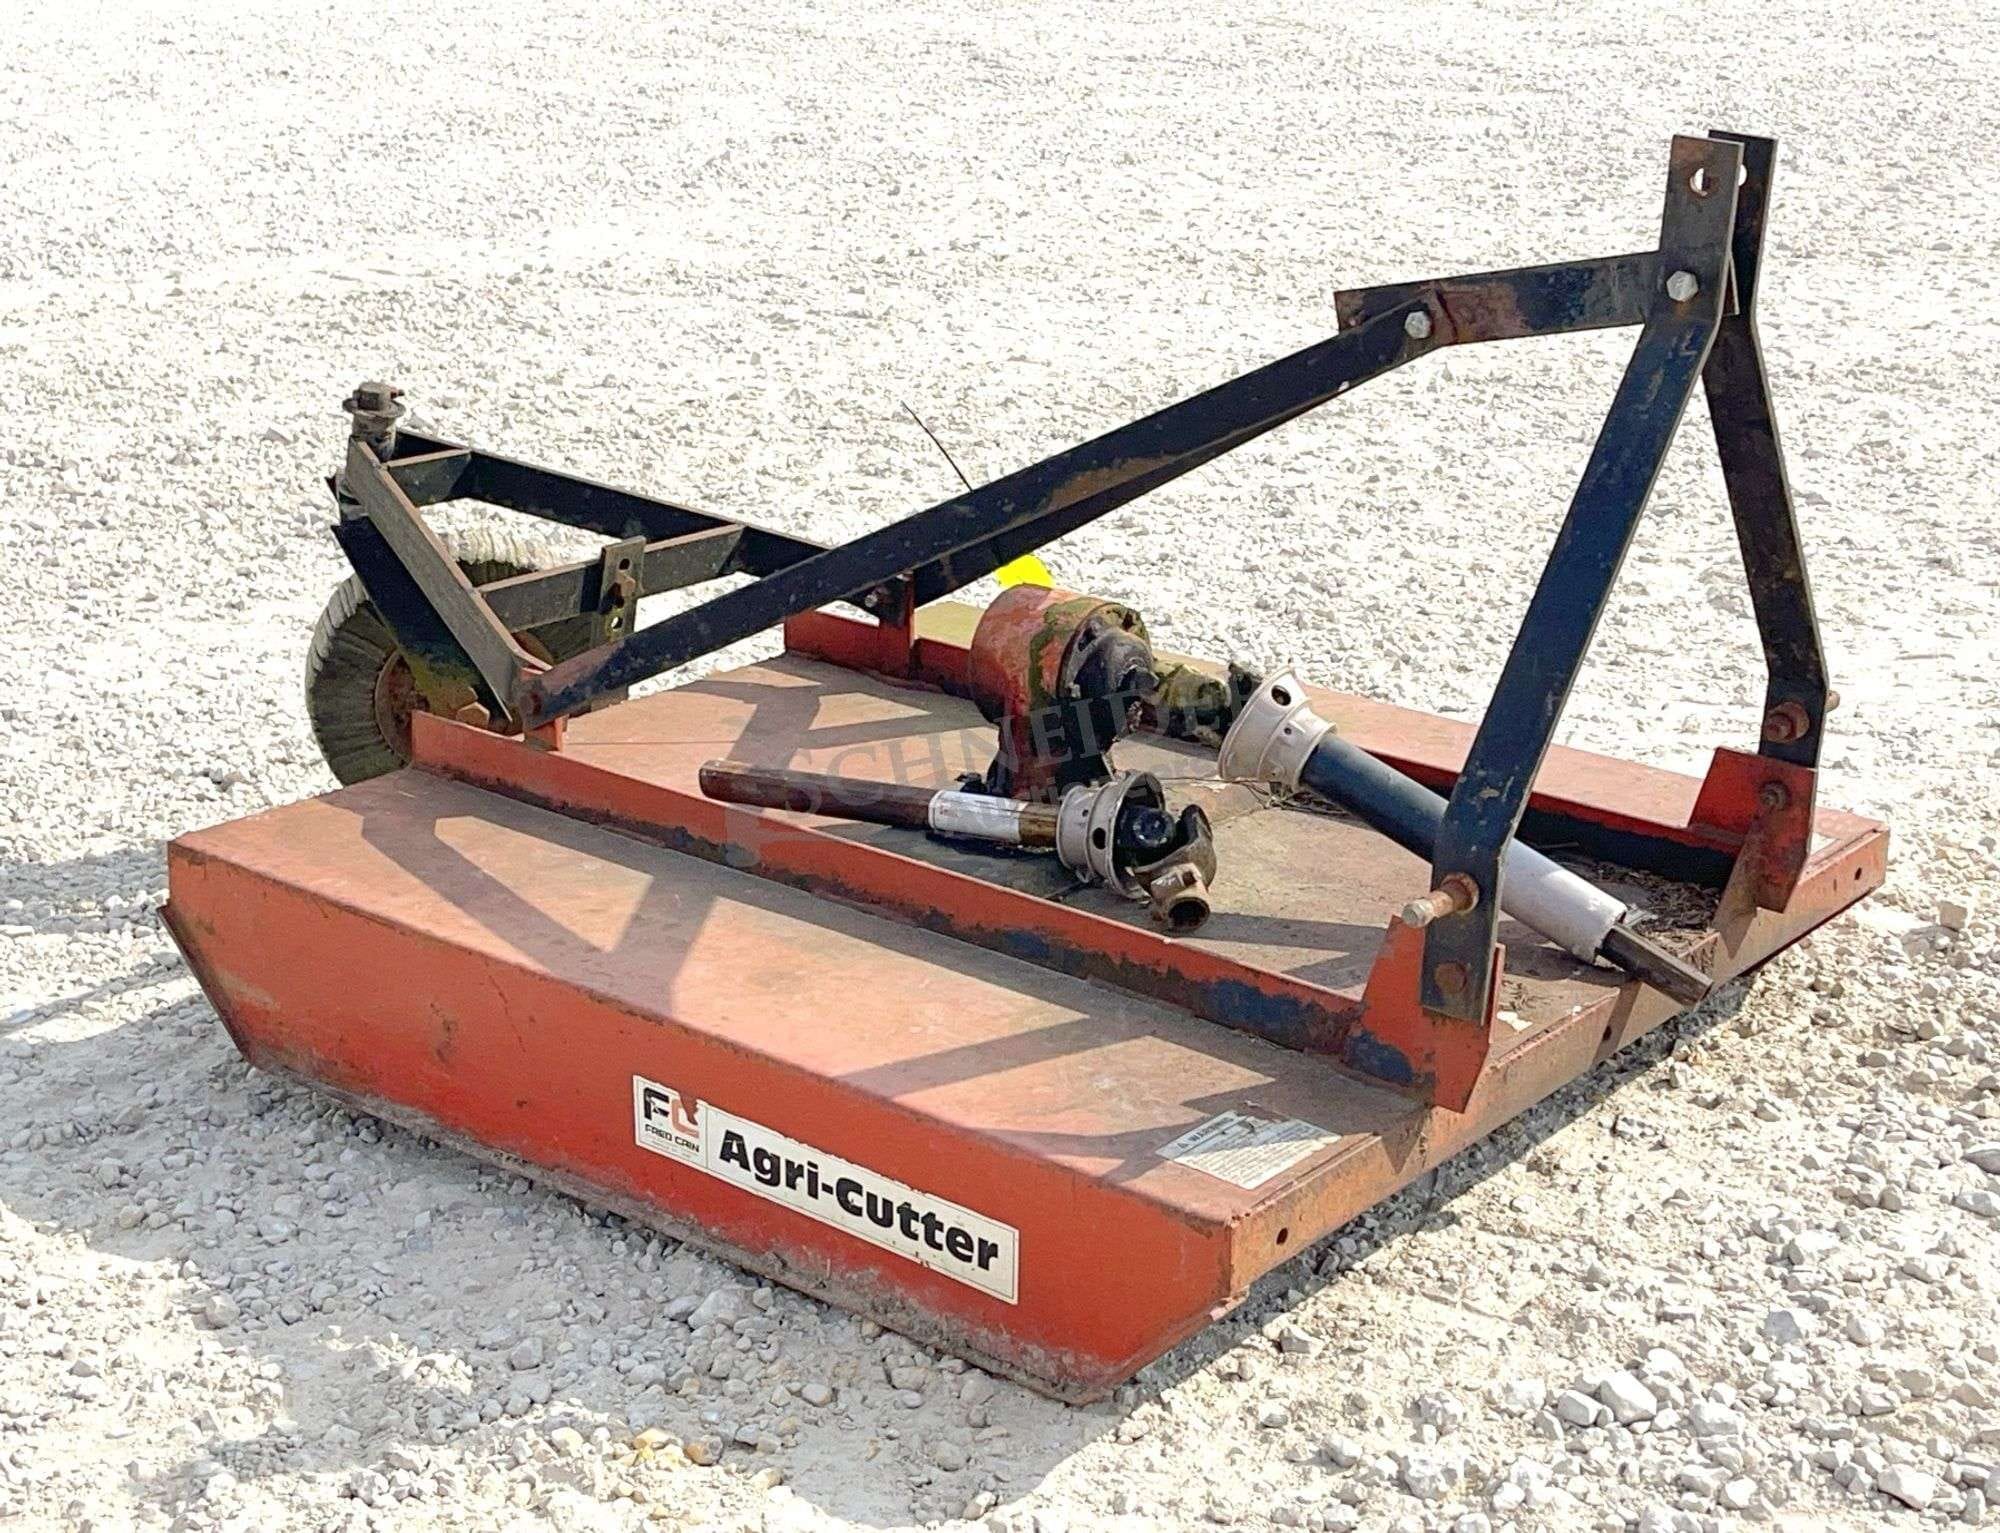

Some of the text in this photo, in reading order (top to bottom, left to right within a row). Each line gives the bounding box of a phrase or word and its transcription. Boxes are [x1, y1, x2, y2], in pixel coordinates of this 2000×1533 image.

[645, 1123, 673, 1142] FRED
[674, 1136, 700, 1153] CAIN
[718, 1129, 1000, 1271] Agri-Cutter
